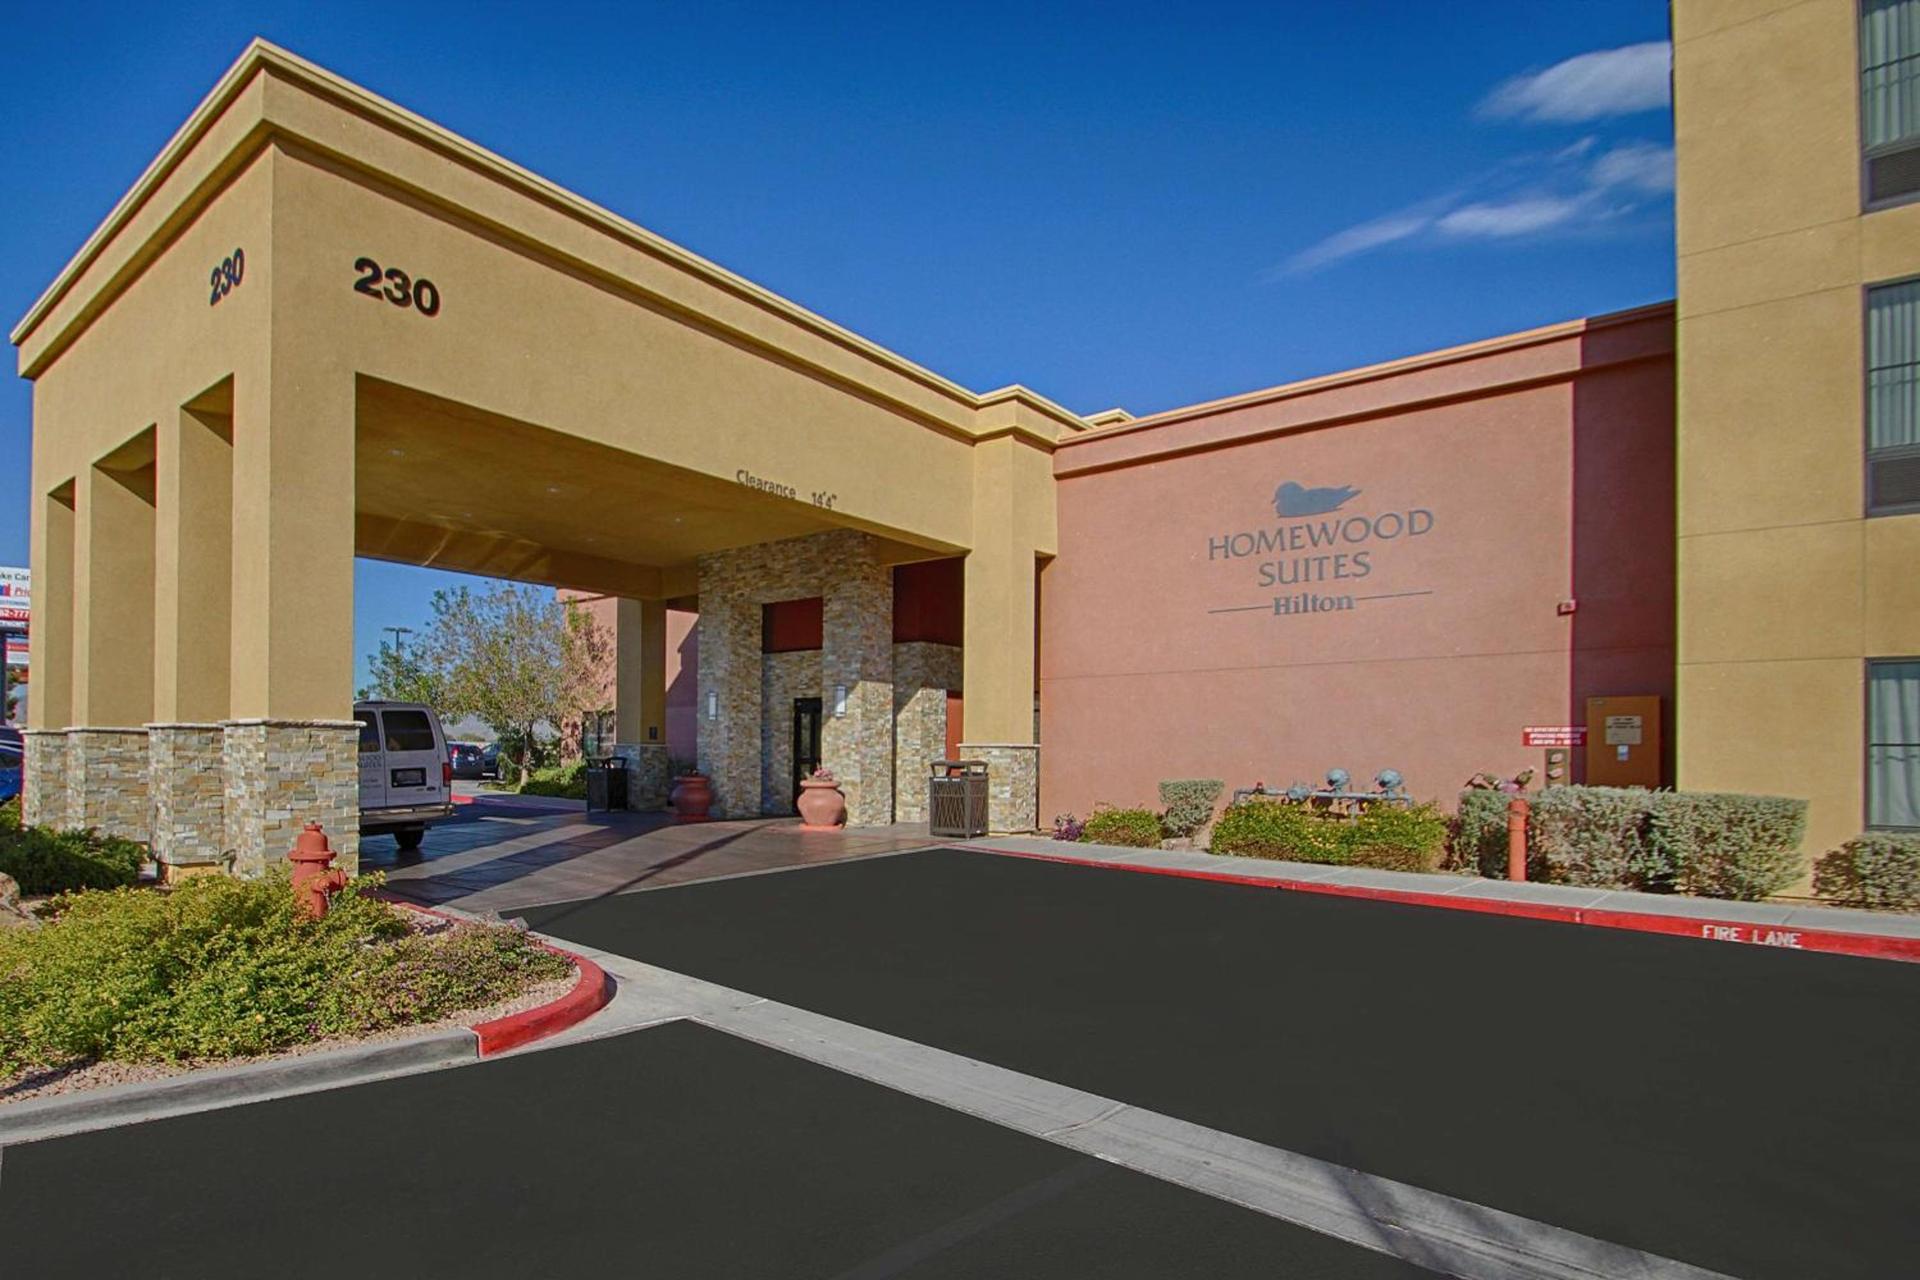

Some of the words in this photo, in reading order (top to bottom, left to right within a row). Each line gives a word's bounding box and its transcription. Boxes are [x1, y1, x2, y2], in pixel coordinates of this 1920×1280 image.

[210, 247, 245, 306] 230
[353, 256, 440, 317] 230
[736, 469, 797, 499] Clearance
[1208, 509, 1434, 560] HOMEWOOD
[1258, 551, 1371, 587] SUITES
[1273, 593, 1354, 615] Hilton
[1703, 925, 1743, 943] FIRE
[1752, 929, 1802, 948] LANE
